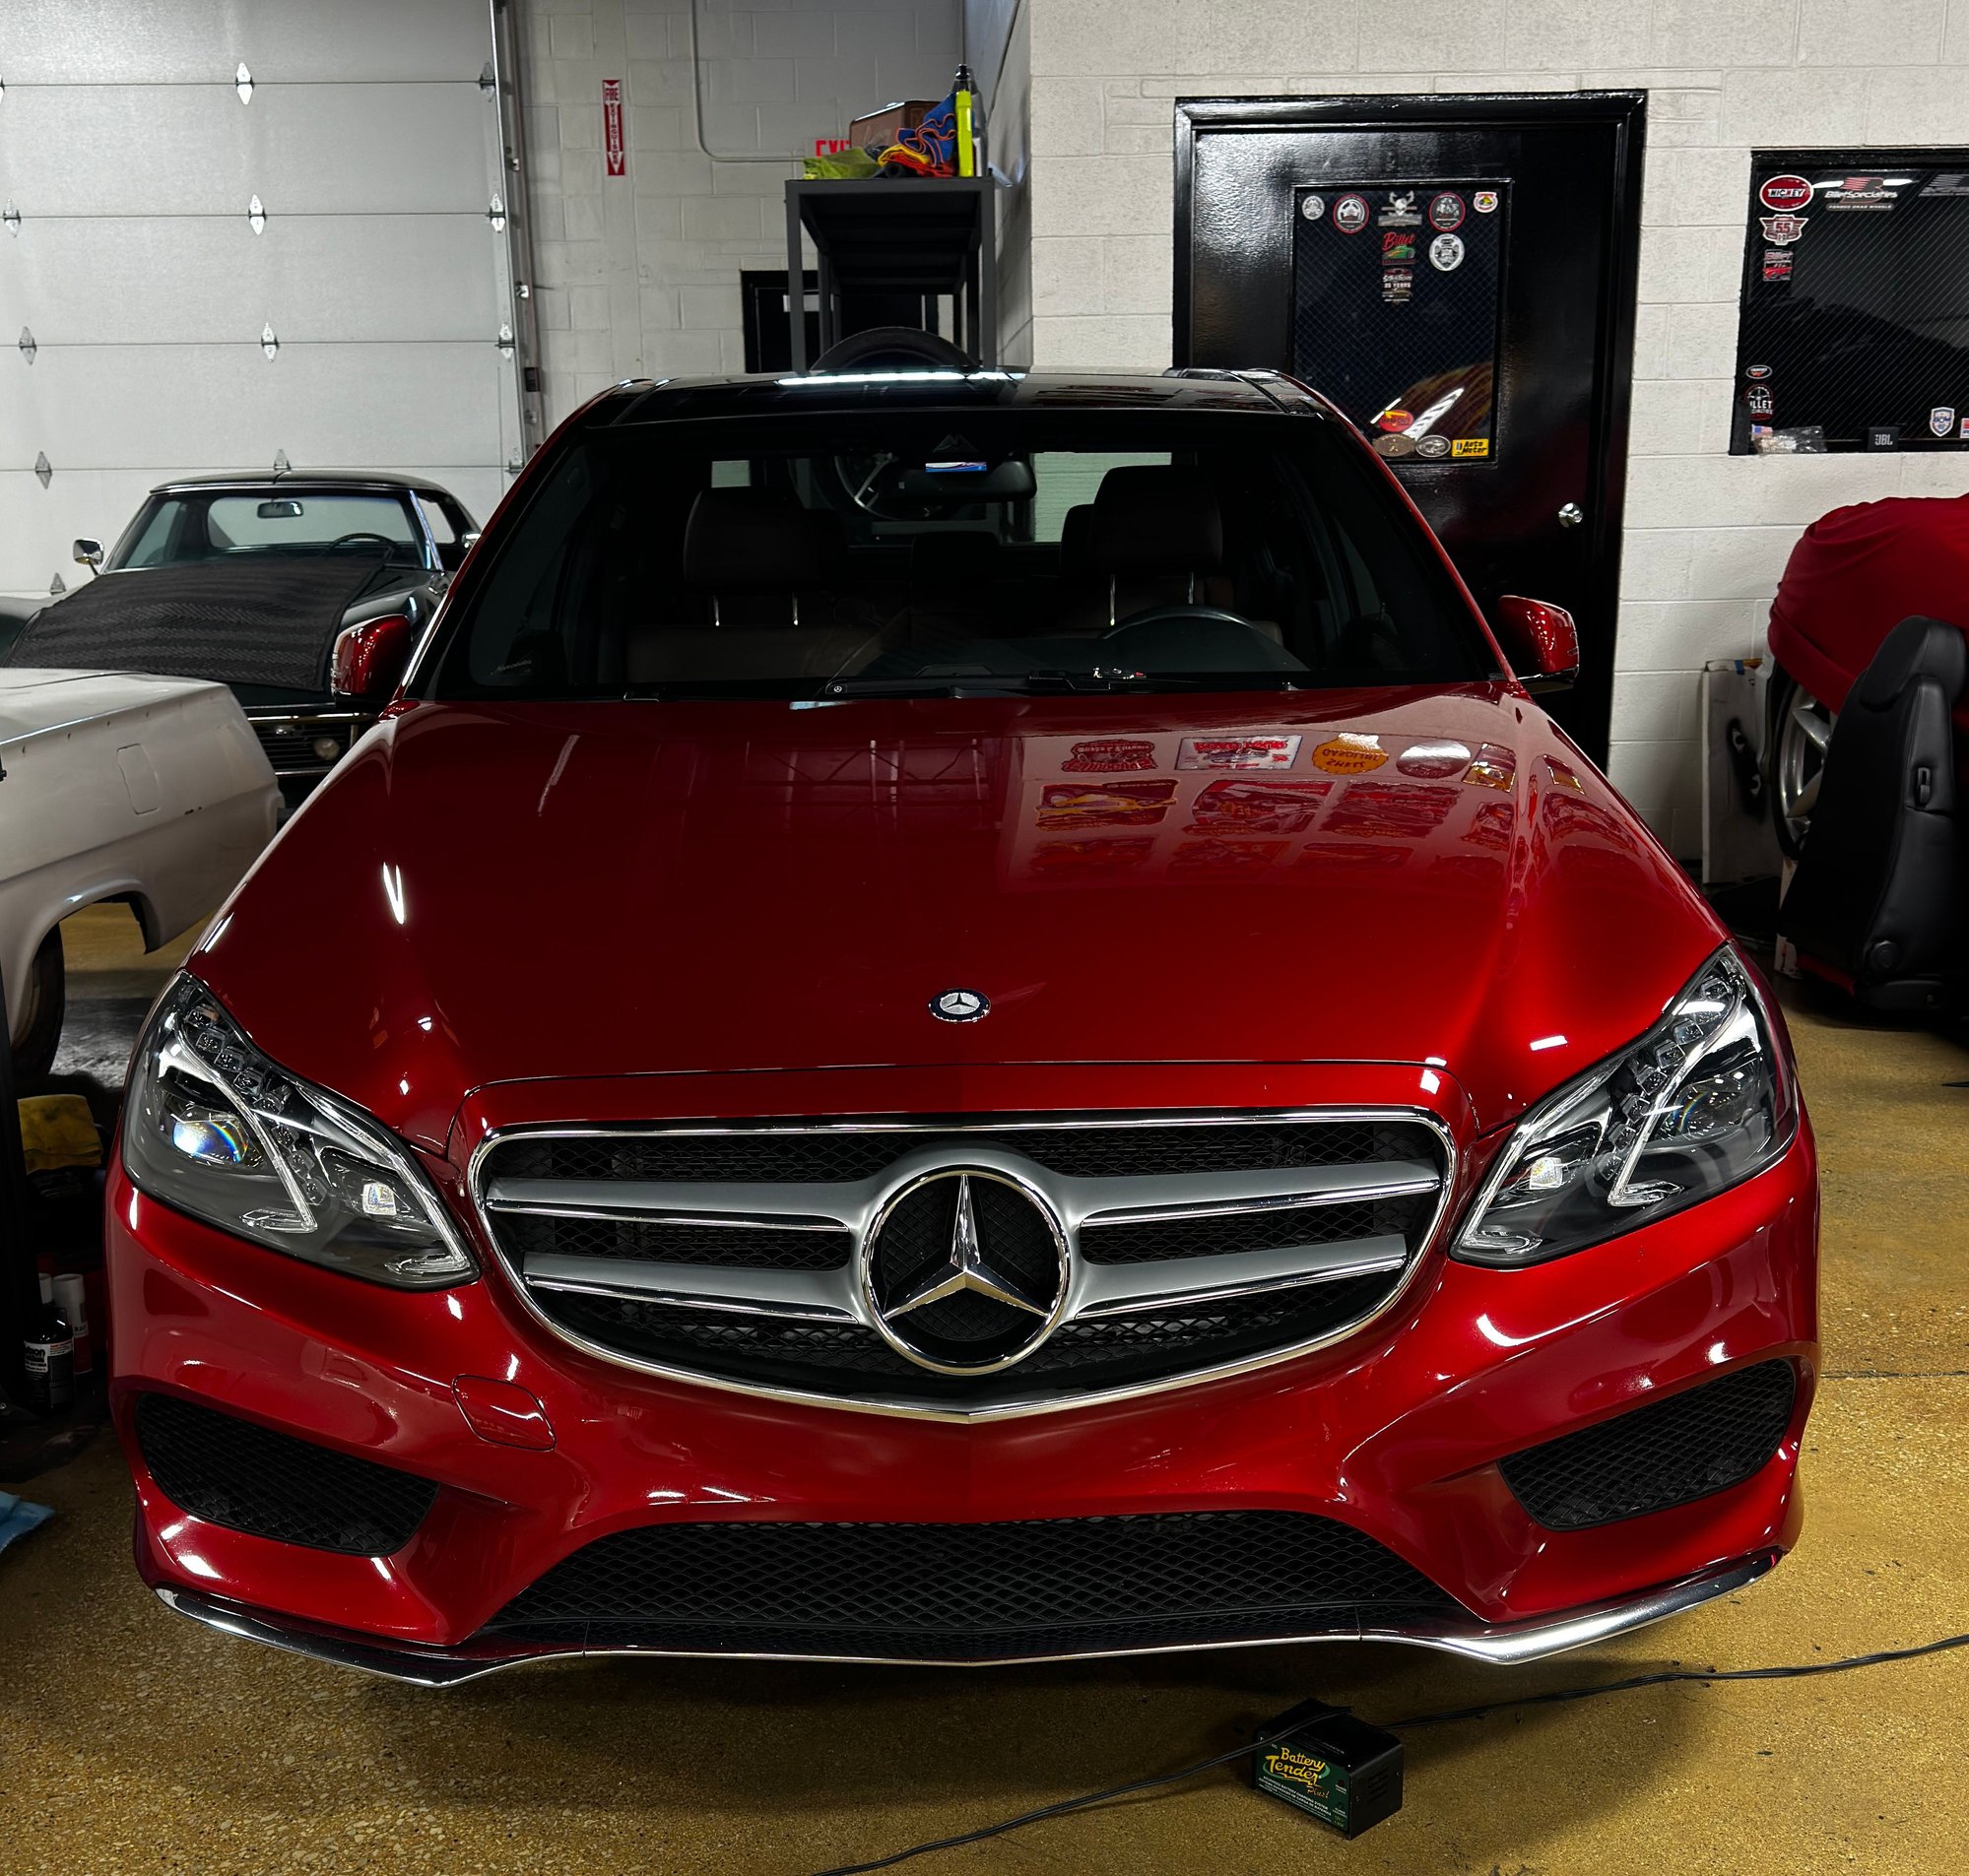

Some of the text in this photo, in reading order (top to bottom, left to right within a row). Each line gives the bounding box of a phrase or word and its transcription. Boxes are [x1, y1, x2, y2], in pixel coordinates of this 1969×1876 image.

[1775, 223, 1791, 234] 55
[1749, 400, 1773, 409] ILLET
[1874, 433, 1893, 446] JBL
[1280, 1747, 1326, 1772] Battery
[1265, 1755, 1319, 1784] Tender
